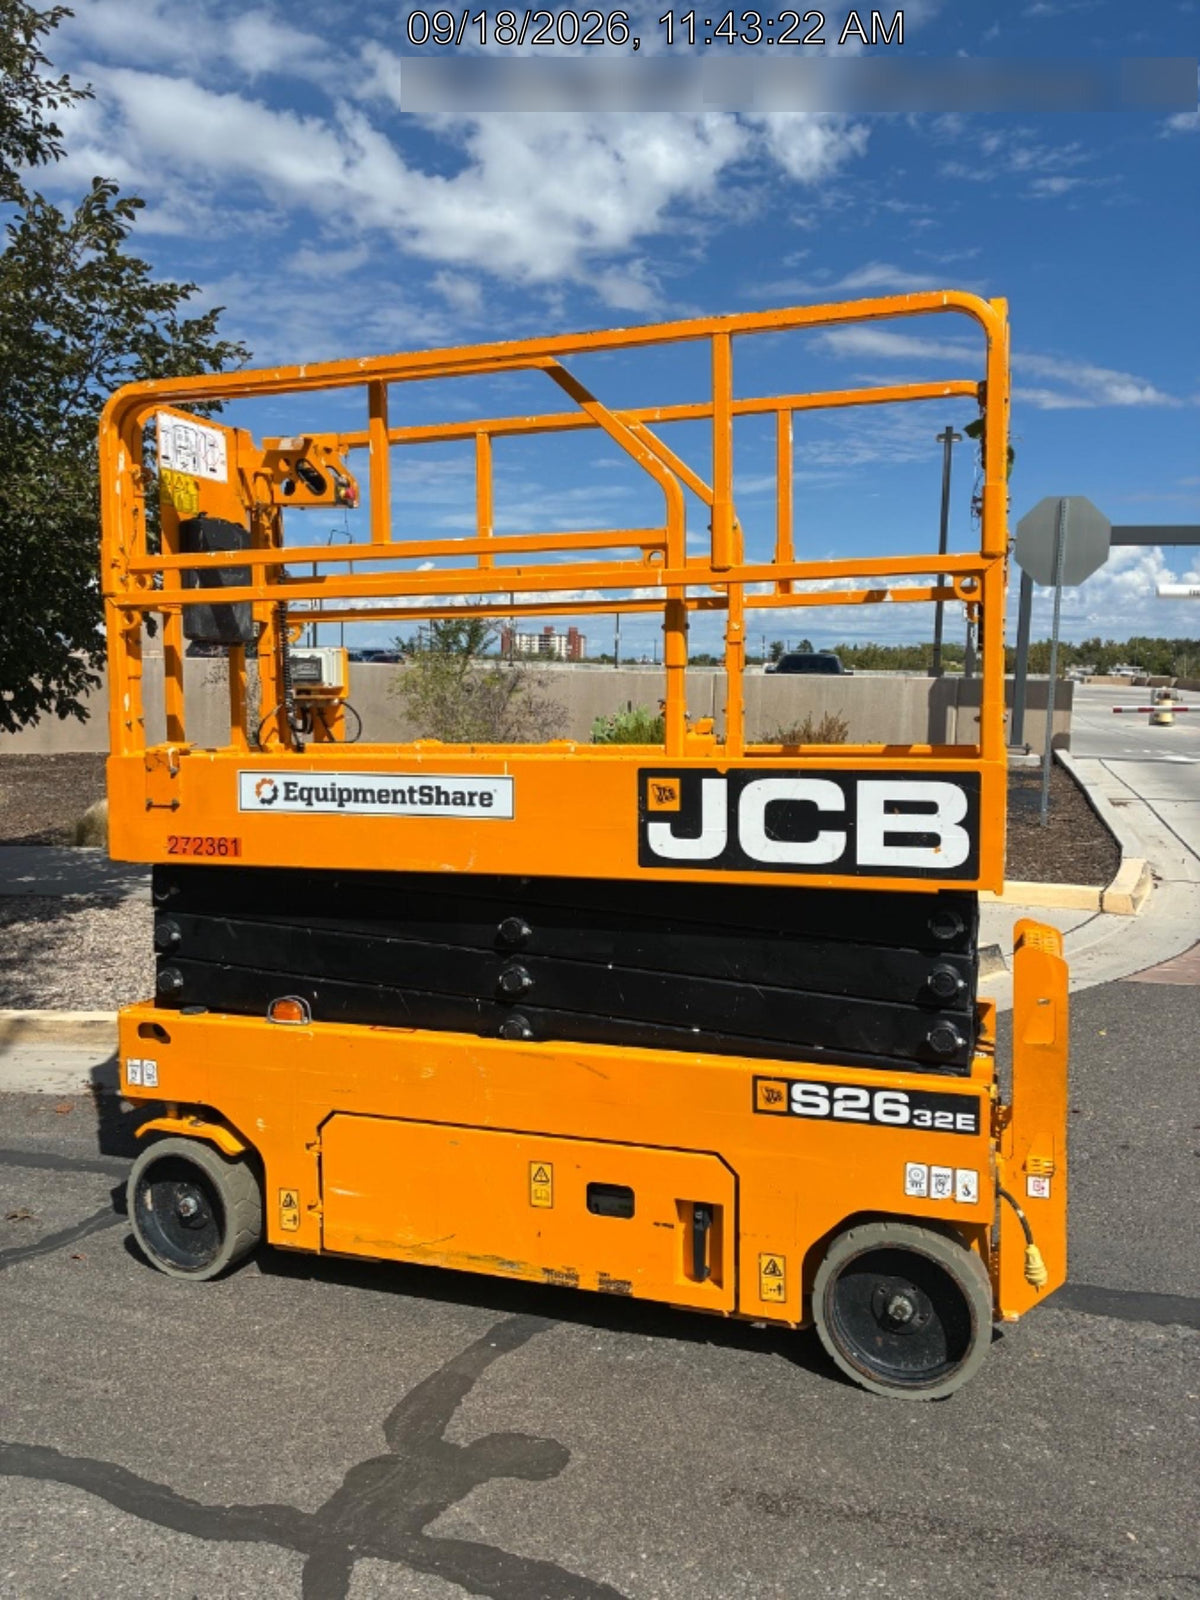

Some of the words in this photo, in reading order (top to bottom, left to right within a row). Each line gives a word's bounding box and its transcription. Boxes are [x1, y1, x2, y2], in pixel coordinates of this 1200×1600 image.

[283, 781, 494, 808] EquipmentShare
[647, 777, 970, 869] JCB
[167, 835, 239, 857] 272361
